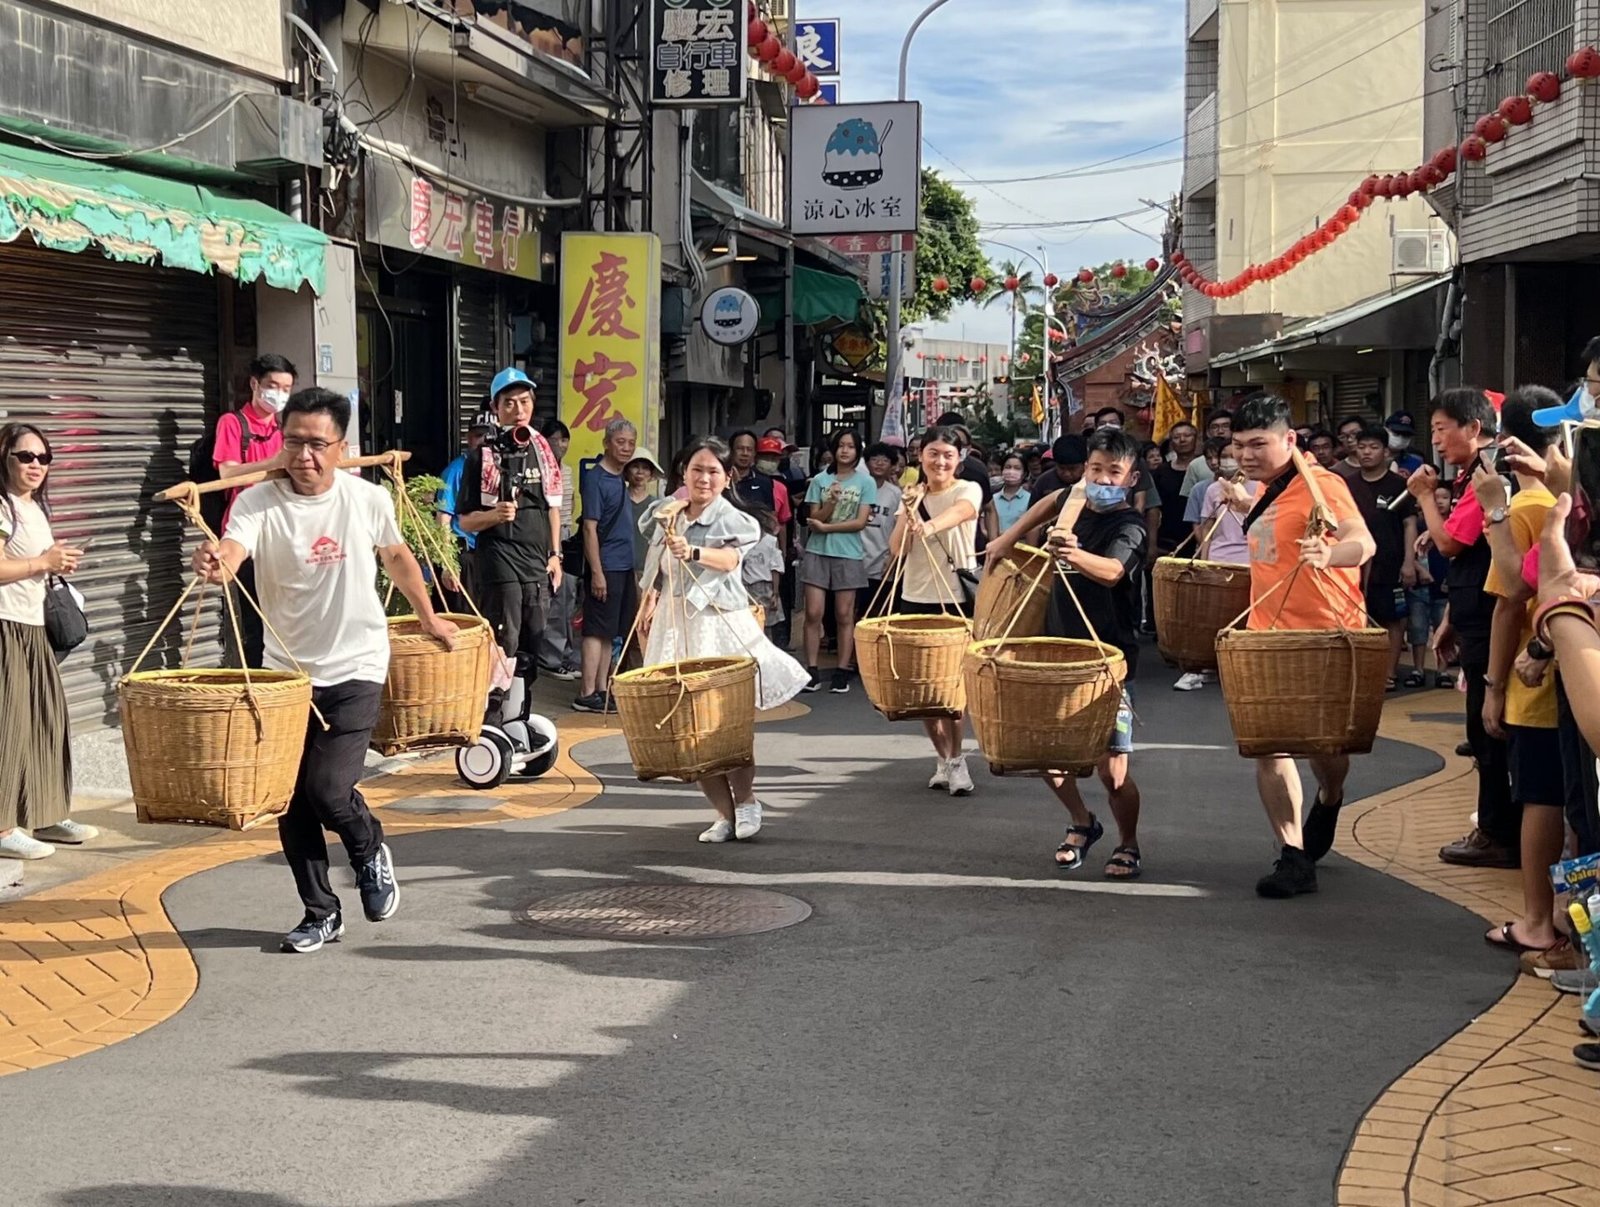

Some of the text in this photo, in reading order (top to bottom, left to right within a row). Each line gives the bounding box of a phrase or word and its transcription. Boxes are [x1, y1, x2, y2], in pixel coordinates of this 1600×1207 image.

[657, 40, 737, 70] 自行車
[663, 69, 731, 97] 修理
[803, 196, 902, 220] 涼心冰室
[568, 251, 640, 433] 慶宏
